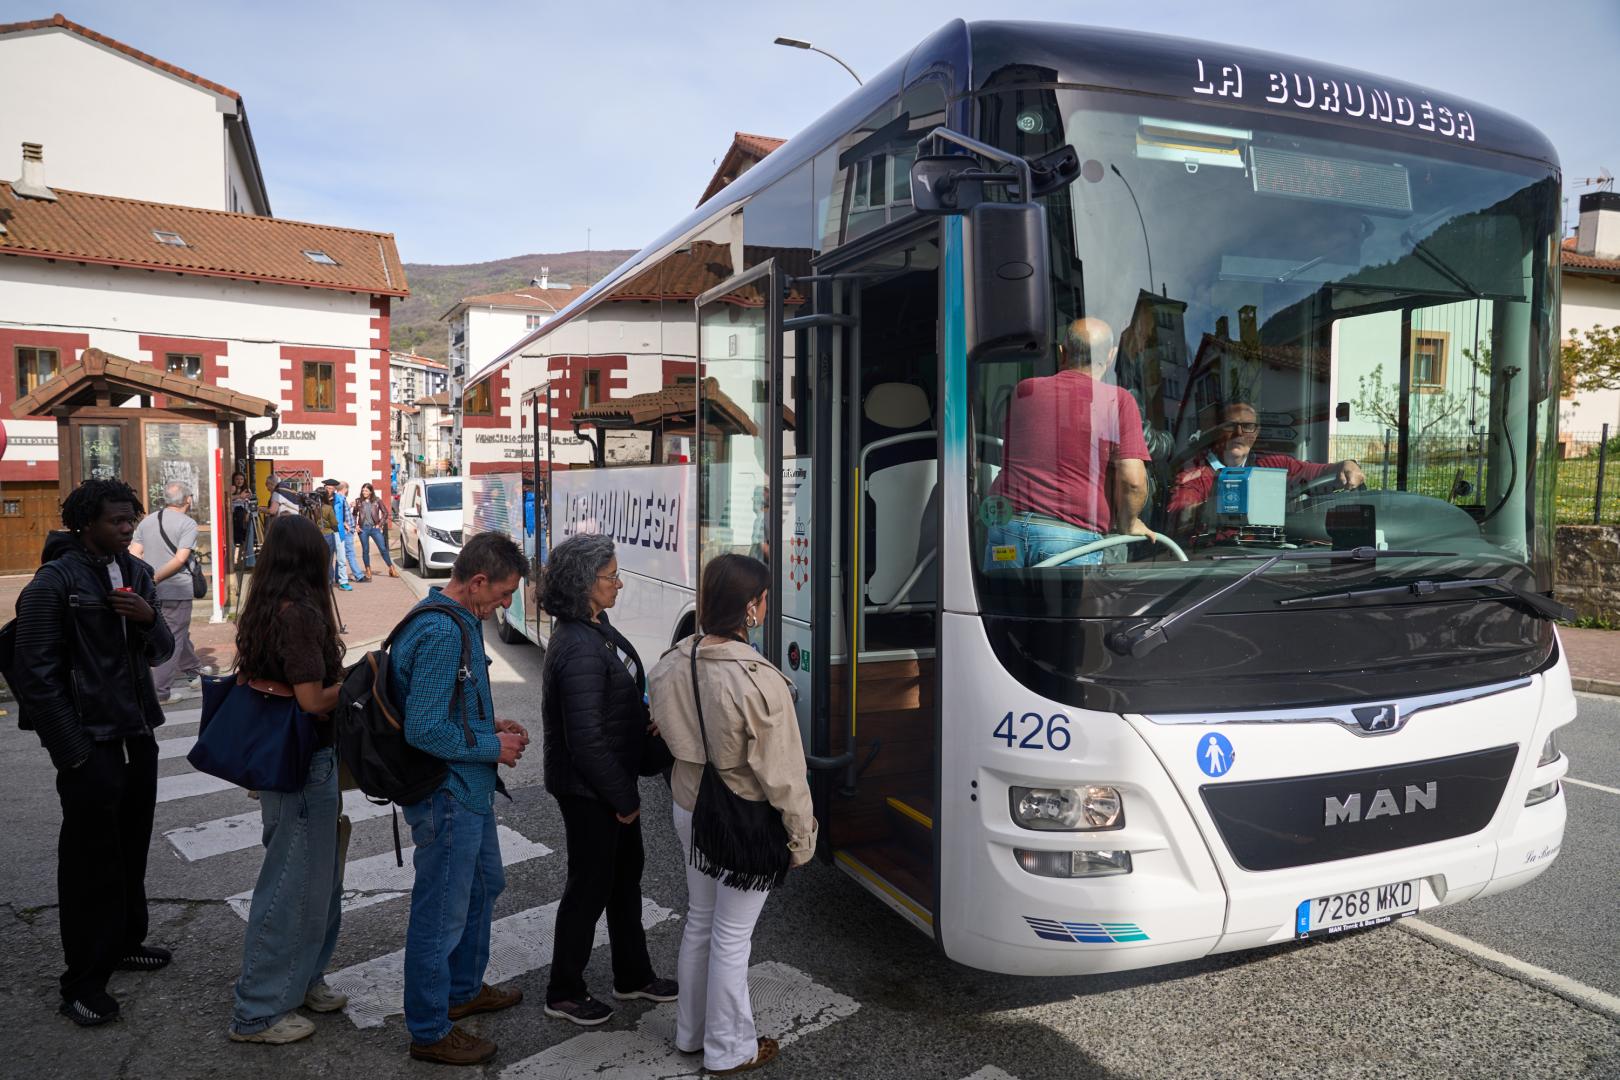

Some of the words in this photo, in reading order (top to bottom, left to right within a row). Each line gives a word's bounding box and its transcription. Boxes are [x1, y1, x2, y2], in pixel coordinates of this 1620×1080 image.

[1192, 58, 1243, 99] LA
[1265, 71, 1476, 142] BURUNDESA
[992, 711, 1071, 751] 426
[1324, 780, 1438, 827] MAN
[1317, 890, 1371, 923] 7268
[1376, 881, 1413, 912] MKD
